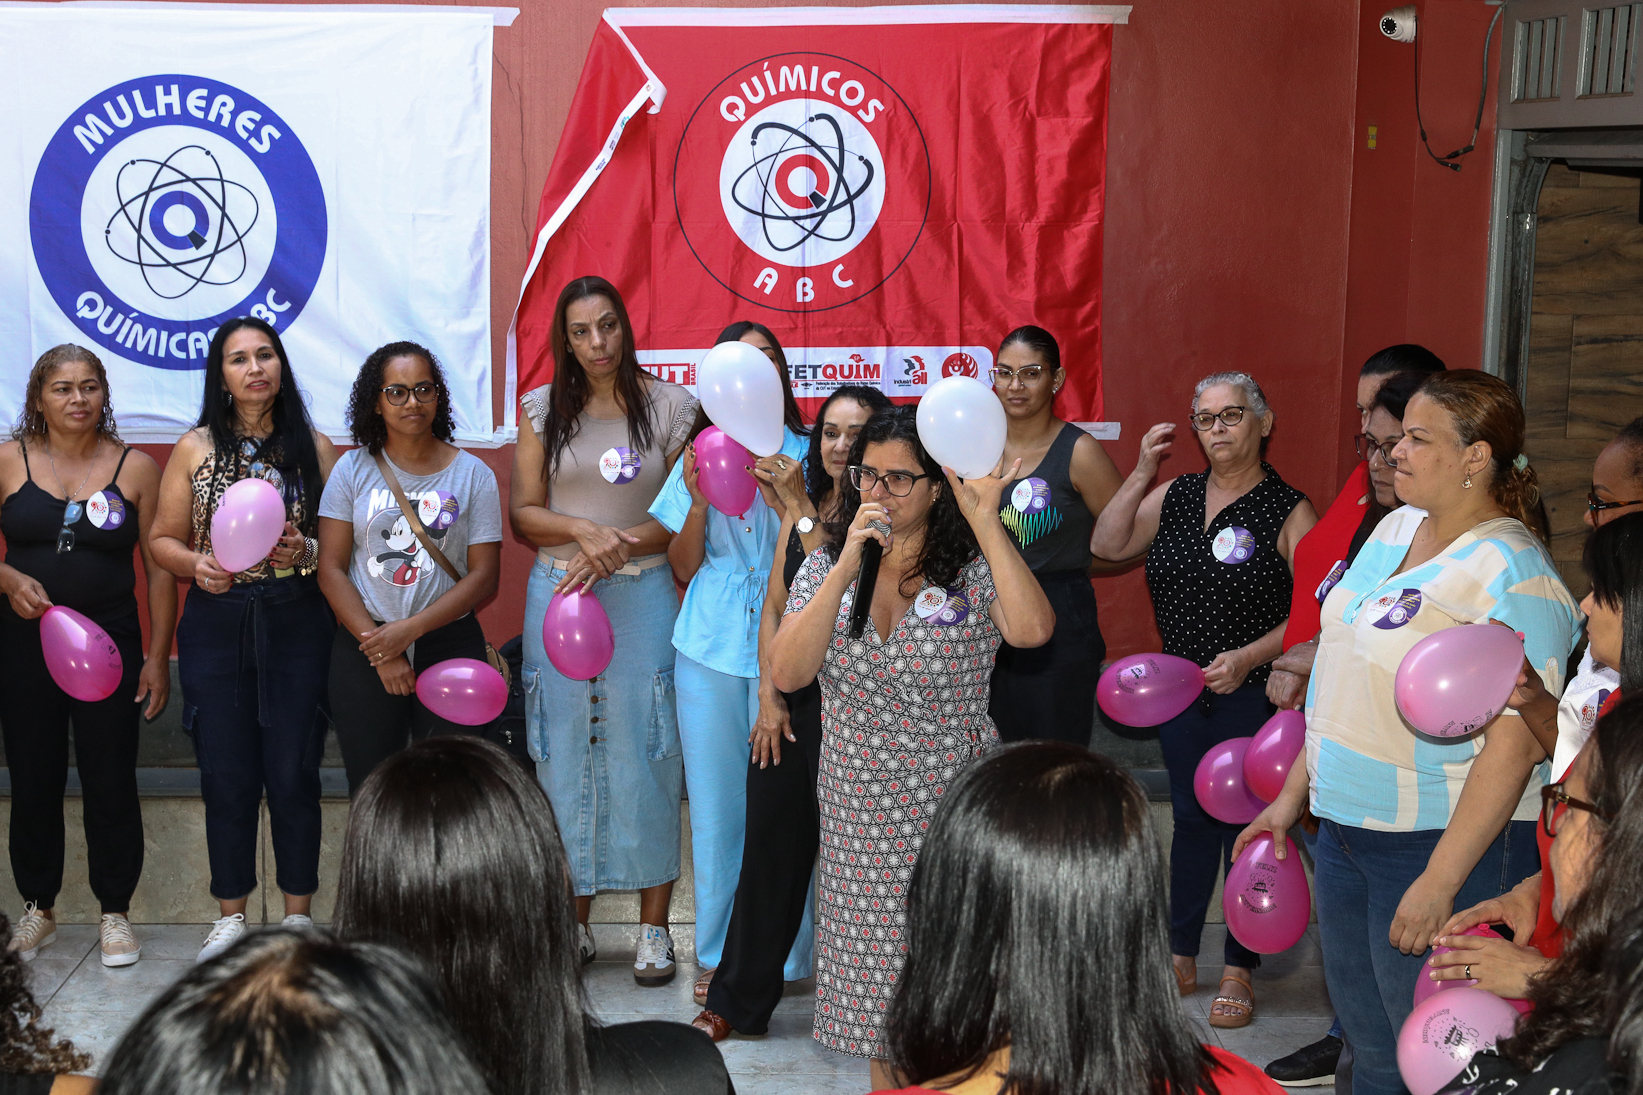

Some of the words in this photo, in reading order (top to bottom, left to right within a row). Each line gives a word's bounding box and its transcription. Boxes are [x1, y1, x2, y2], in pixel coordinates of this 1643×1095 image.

[73, 84, 282, 155] MULHERES
[720, 61, 885, 123] QUÍMICOS
[238, 287, 292, 327] BC
